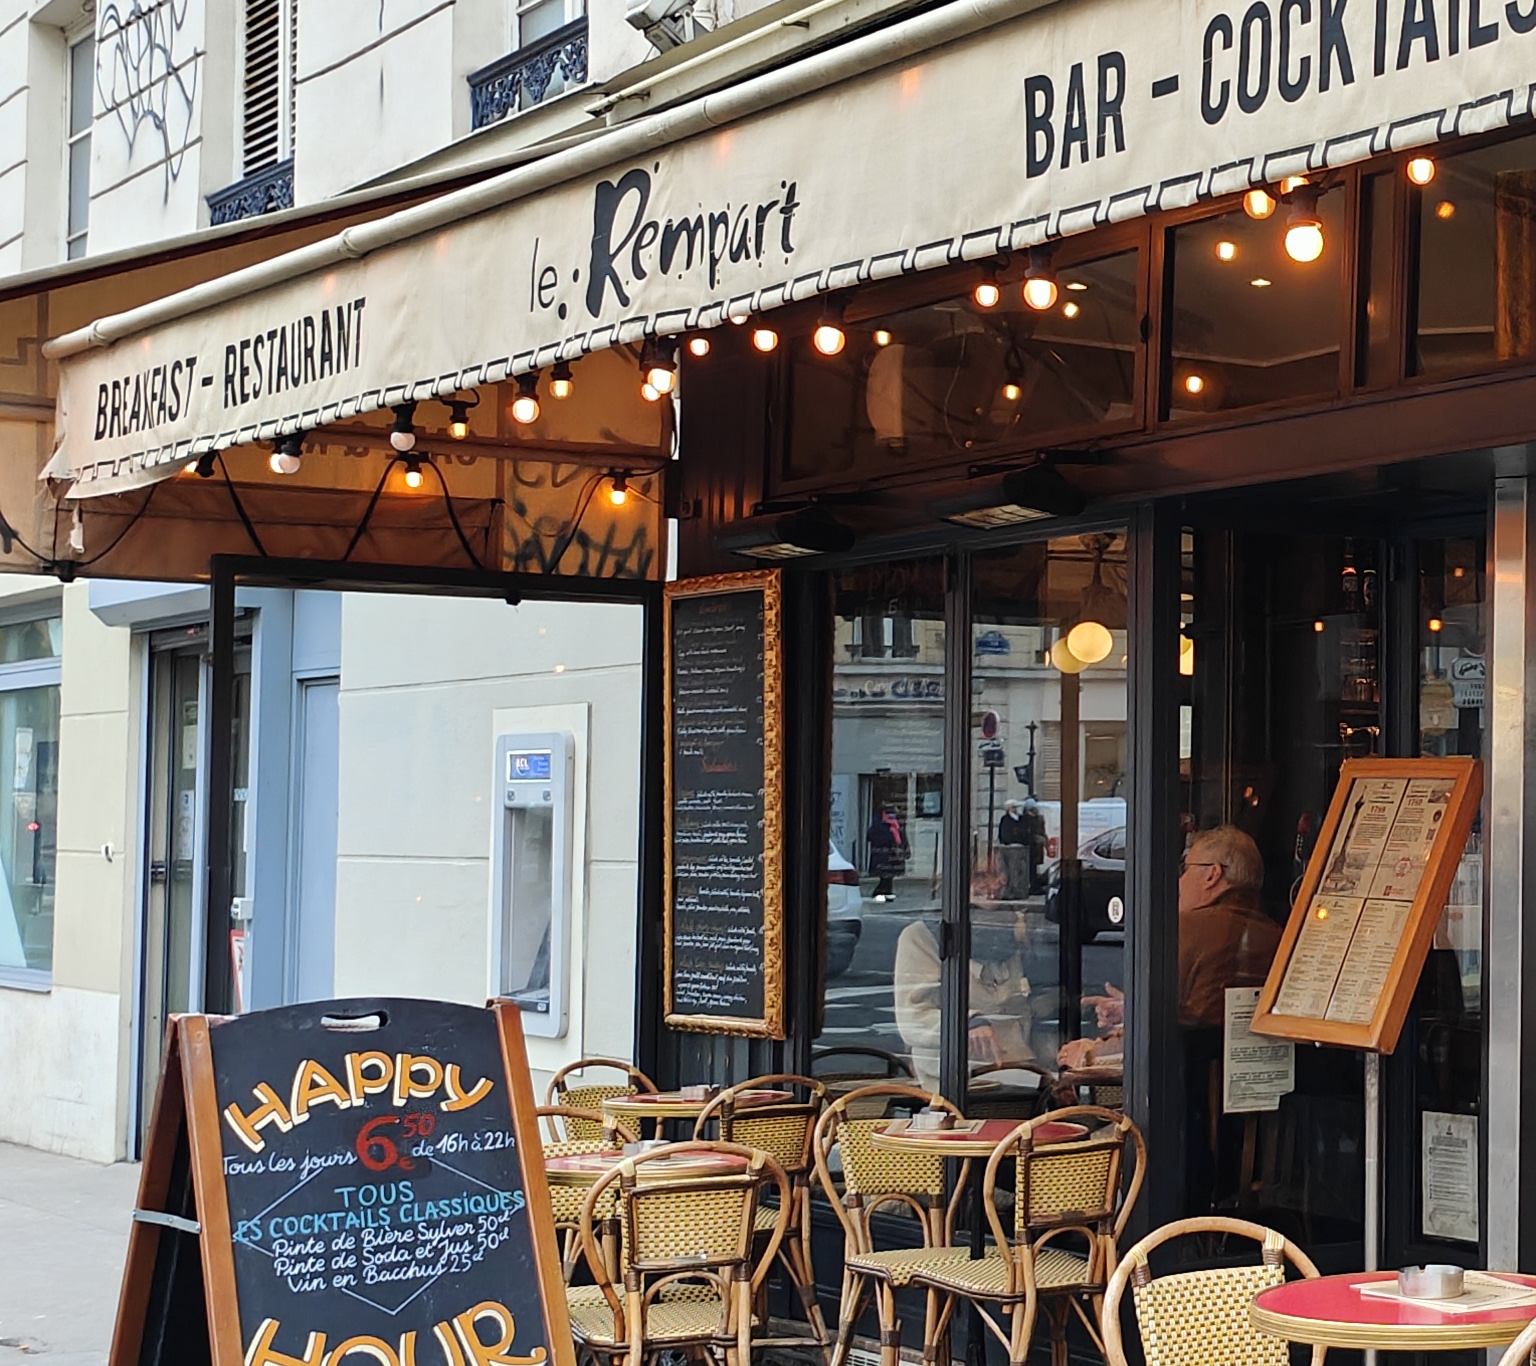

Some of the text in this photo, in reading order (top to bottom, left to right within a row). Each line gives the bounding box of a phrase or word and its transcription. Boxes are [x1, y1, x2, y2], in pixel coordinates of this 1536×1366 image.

[1023, 50, 1127, 180] BAR
[586, 168, 801, 319] Rempart
[94, 355, 198, 441] BREAKFAST
[223, 296, 367, 409] RESTAURANT
[223, 1131, 515, 1180] Tous les jours de 16h à 22h
[232, 1190, 525, 1242] ES COCKTAILS CLASSIQUES
[334, 1180, 414, 1209] TOUS
[272, 1237, 325, 1258] Pinte
[330, 1234, 355, 1253] de
[362, 1226, 414, 1249] Bière
[417, 1220, 475, 1249] Sylver
[273, 1256, 326, 1278] Pinte
[331, 1253, 357, 1270] de
[361, 1246, 411, 1267] Soda
[415, 1243, 435, 1262] et
[439, 1241, 474, 1265] Jus
[288, 1272, 326, 1294] Vin
[332, 1274, 357, 1288] en
[363, 1259, 447, 1285] Bacchus
